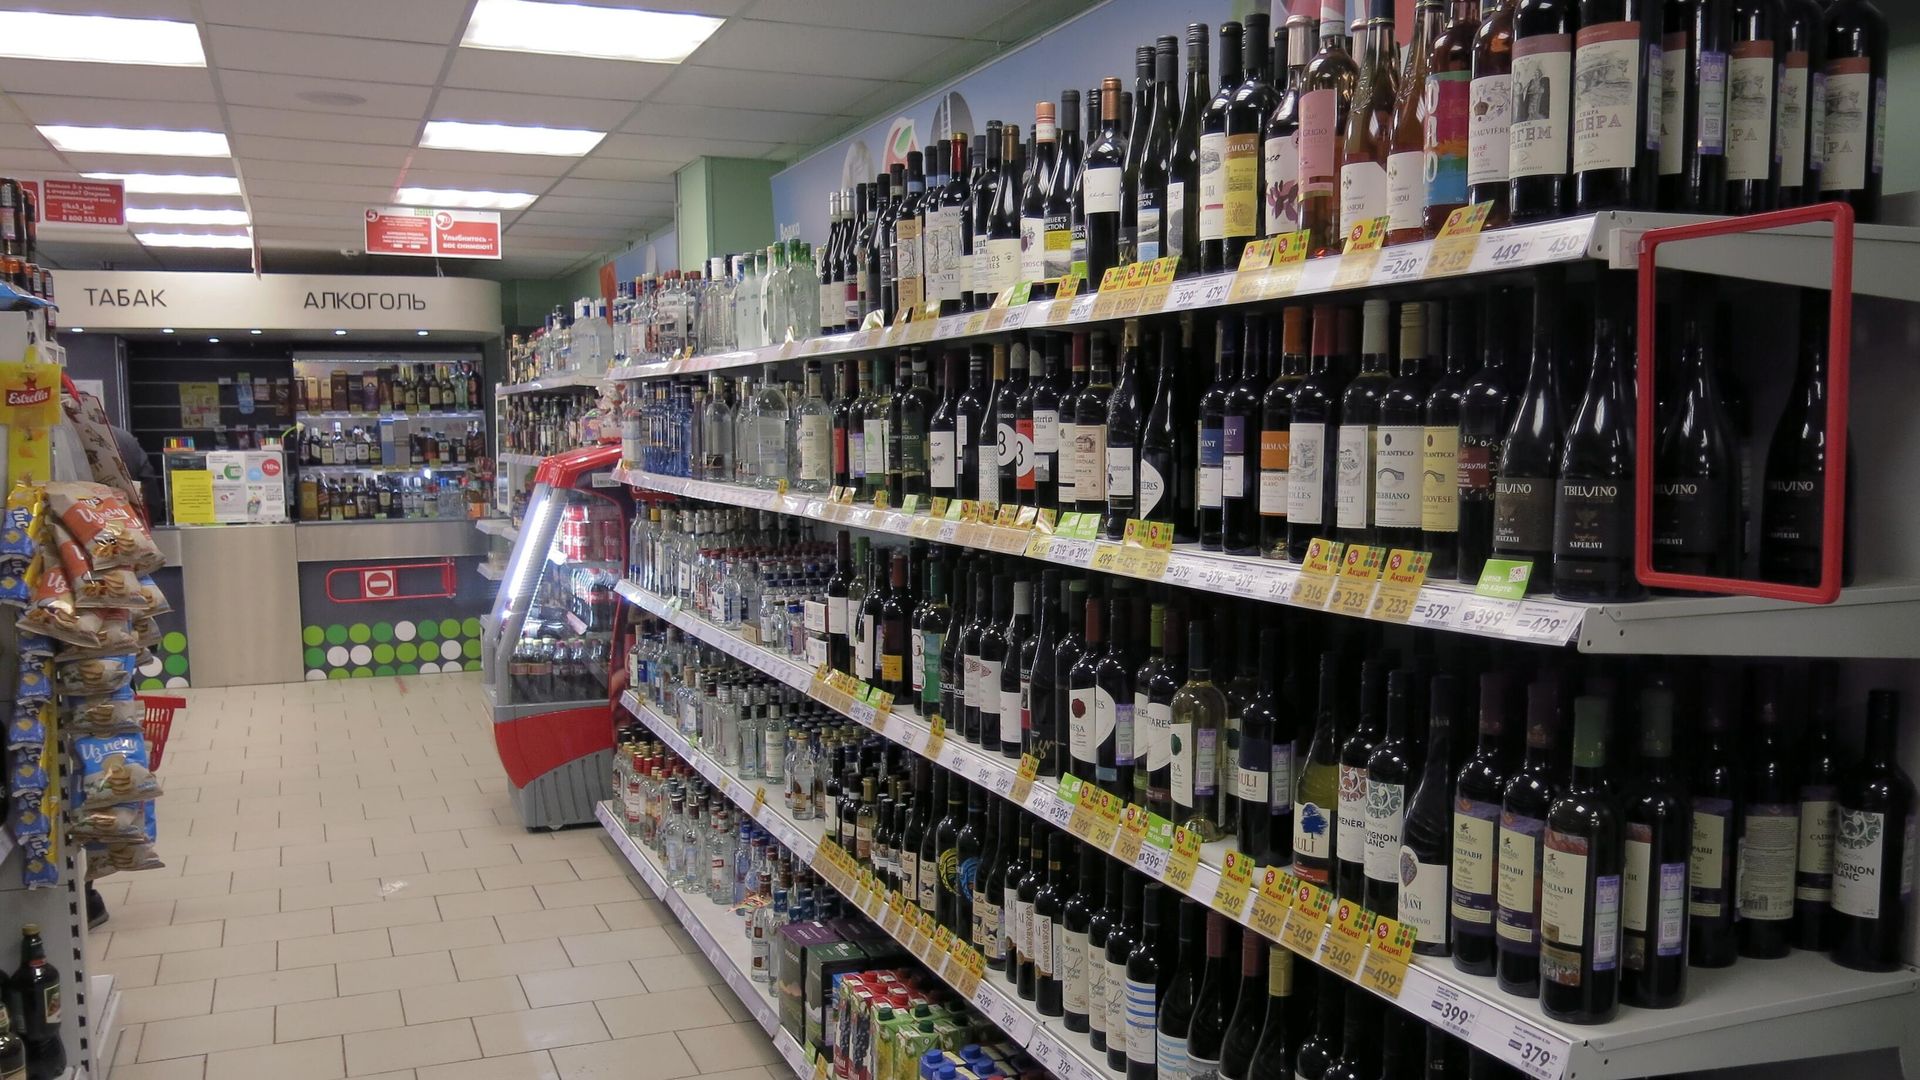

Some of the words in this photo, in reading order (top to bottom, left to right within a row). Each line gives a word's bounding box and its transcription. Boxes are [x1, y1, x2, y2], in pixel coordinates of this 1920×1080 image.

[1492, 243, 1521, 262] 449
[1391, 258, 1417, 275] 249
[84, 288, 167, 307] ТАБАК
[303, 292, 426, 310] АЛКОГОЛЬ
[8, 391, 49, 404] Estrella
[1564, 485, 1617, 497] TBILVINO
[1569, 541, 1603, 549] SAPERAVI
[1098, 553, 1114, 565] 499
[1173, 565, 1189, 578] 379
[1206, 570, 1223, 584] 379
[1347, 567, 1370, 578] Акция!
[1390, 572, 1415, 583] Акция!
[1235, 573, 1252, 587] 379
[1269, 580, 1287, 594] 379
[1304, 584, 1322, 600] 316
[1343, 591, 1365, 607] 233
[1385, 598, 1408, 614] 233
[1425, 603, 1450, 619] 579
[1475, 608, 1503, 626] 399
[1530, 616, 1561, 634] 429
[1032, 798, 1046, 811] 499
[1055, 807, 1068, 820] 399
[1145, 854, 1160, 868] 399
[1172, 867, 1187, 882] 349
[1227, 870, 1245, 882] Акция!
[1223, 892, 1240, 909] 349
[1265, 886, 1284, 902] Акция!
[1258, 910, 1277, 928] 349
[1299, 903, 1320, 920] Акция!
[1294, 925, 1313, 943] 349
[1338, 922, 1360, 940] Акция!
[1329, 946, 1350, 965] 349
[1378, 941, 1402, 957] Акция!
[1374, 969, 1396, 988] 499
[1442, 1002, 1469, 1025] 399
[1036, 1041, 1049, 1055] 379
[1522, 1042, 1550, 1067] 379
[1058, 1059, 1071, 1073] 379
